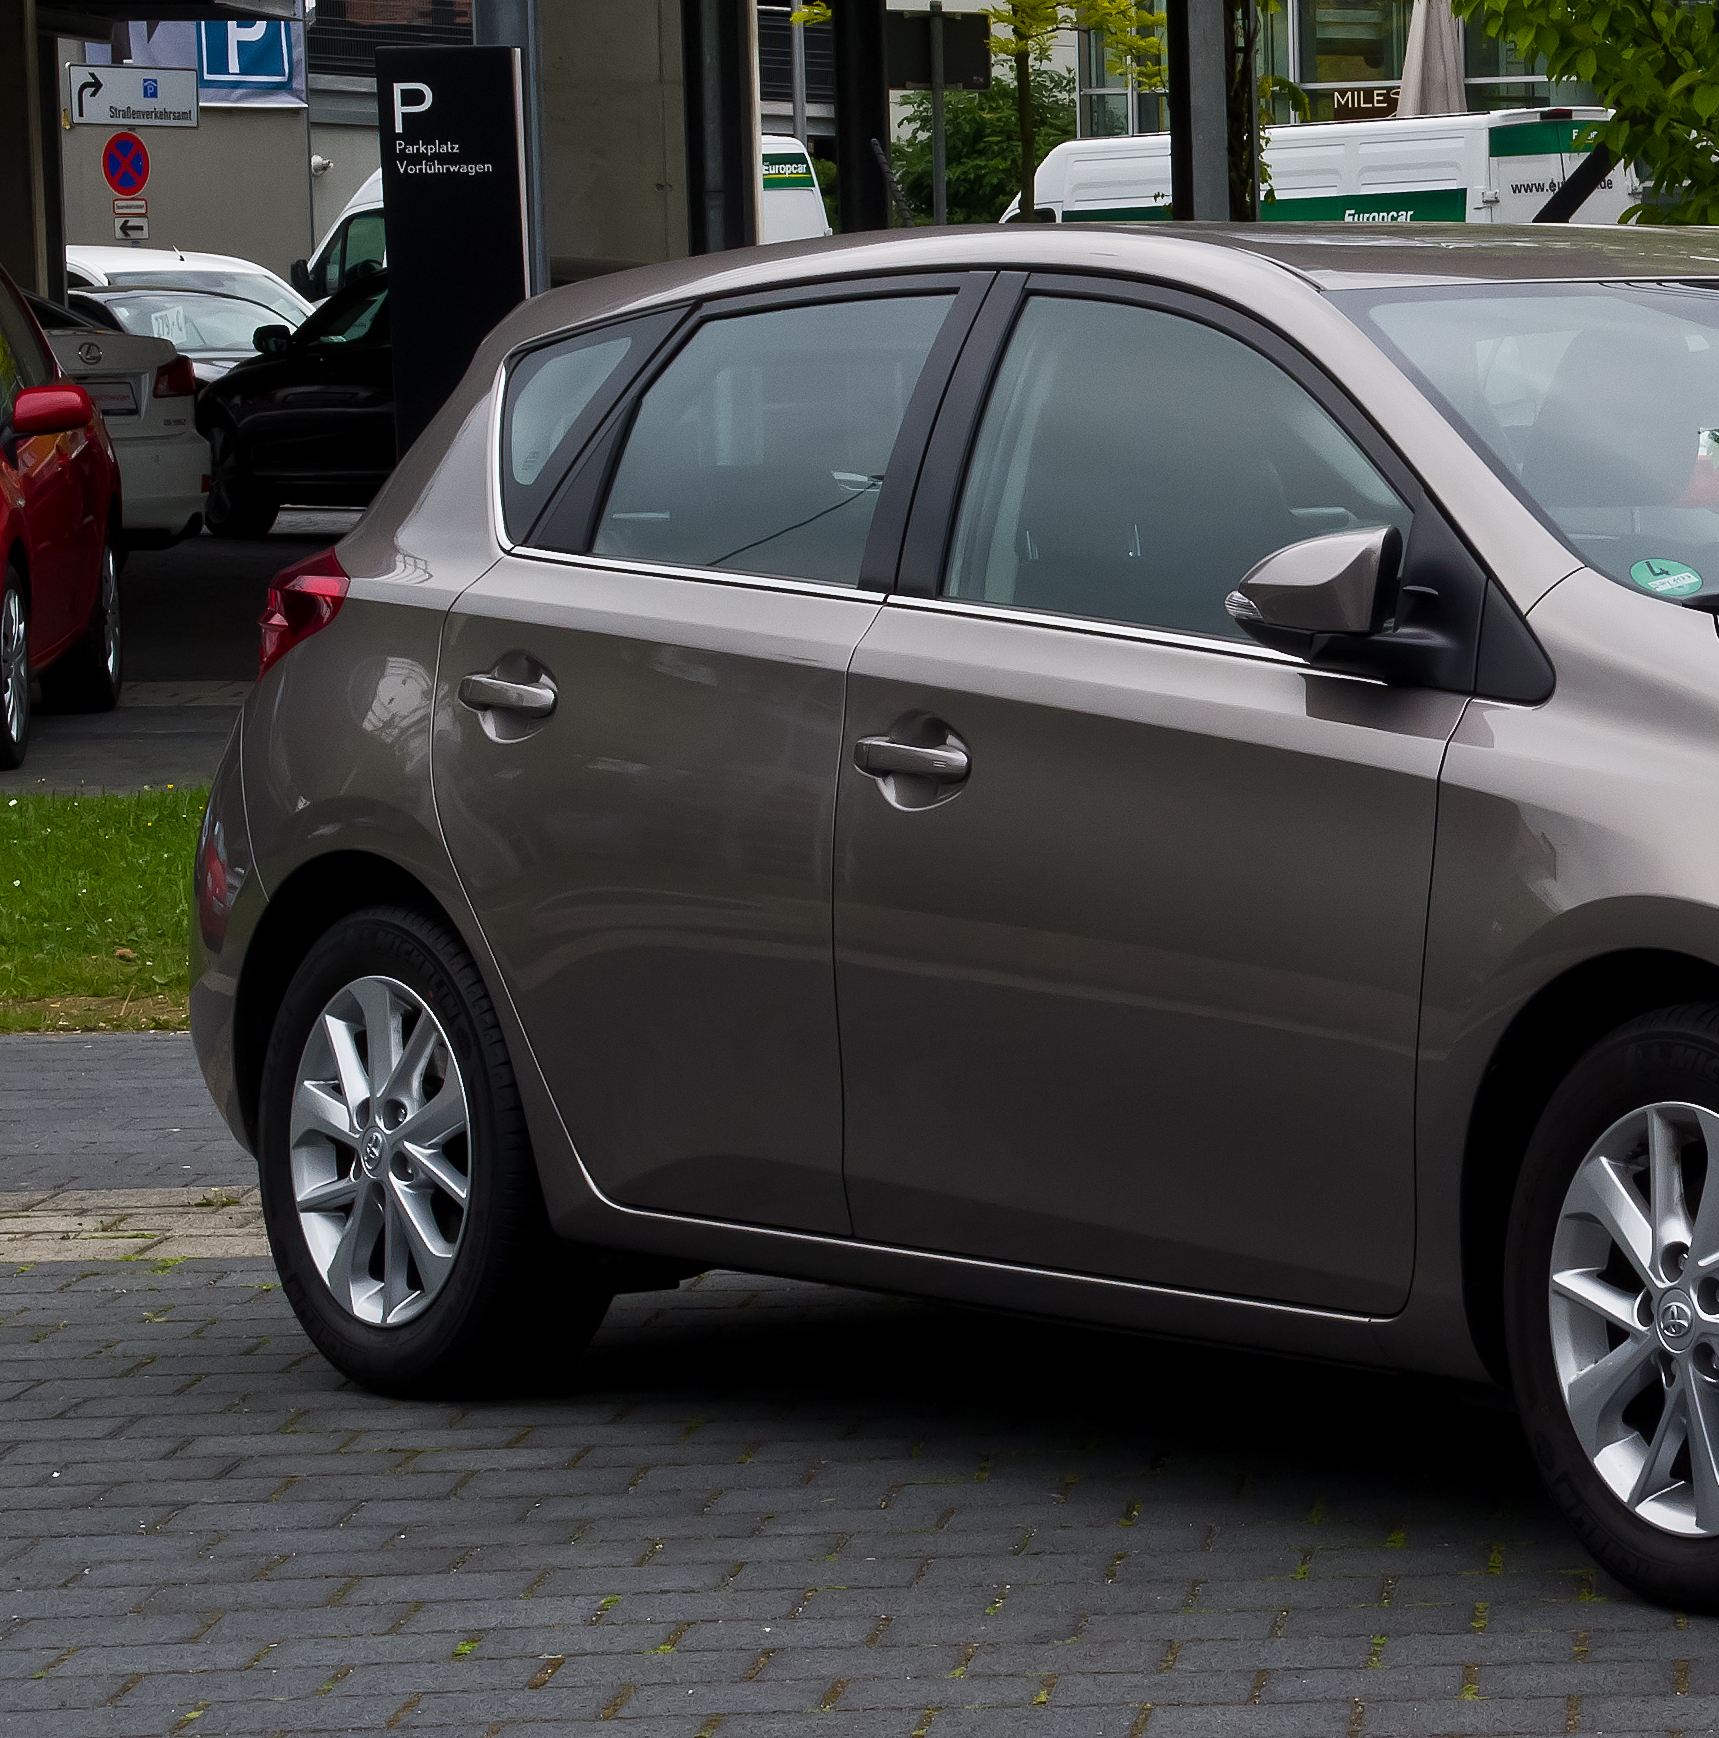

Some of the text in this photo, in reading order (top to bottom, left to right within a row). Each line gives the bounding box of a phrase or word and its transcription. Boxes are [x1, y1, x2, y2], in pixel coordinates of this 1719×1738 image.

[109, 106, 192, 121] Straßenverkehrsamt
[393, 83, 433, 133] P
[396, 140, 460, 156] Parkplatz
[396, 160, 493, 176] Vorführwagen
[762, 162, 807, 177] Europcar
